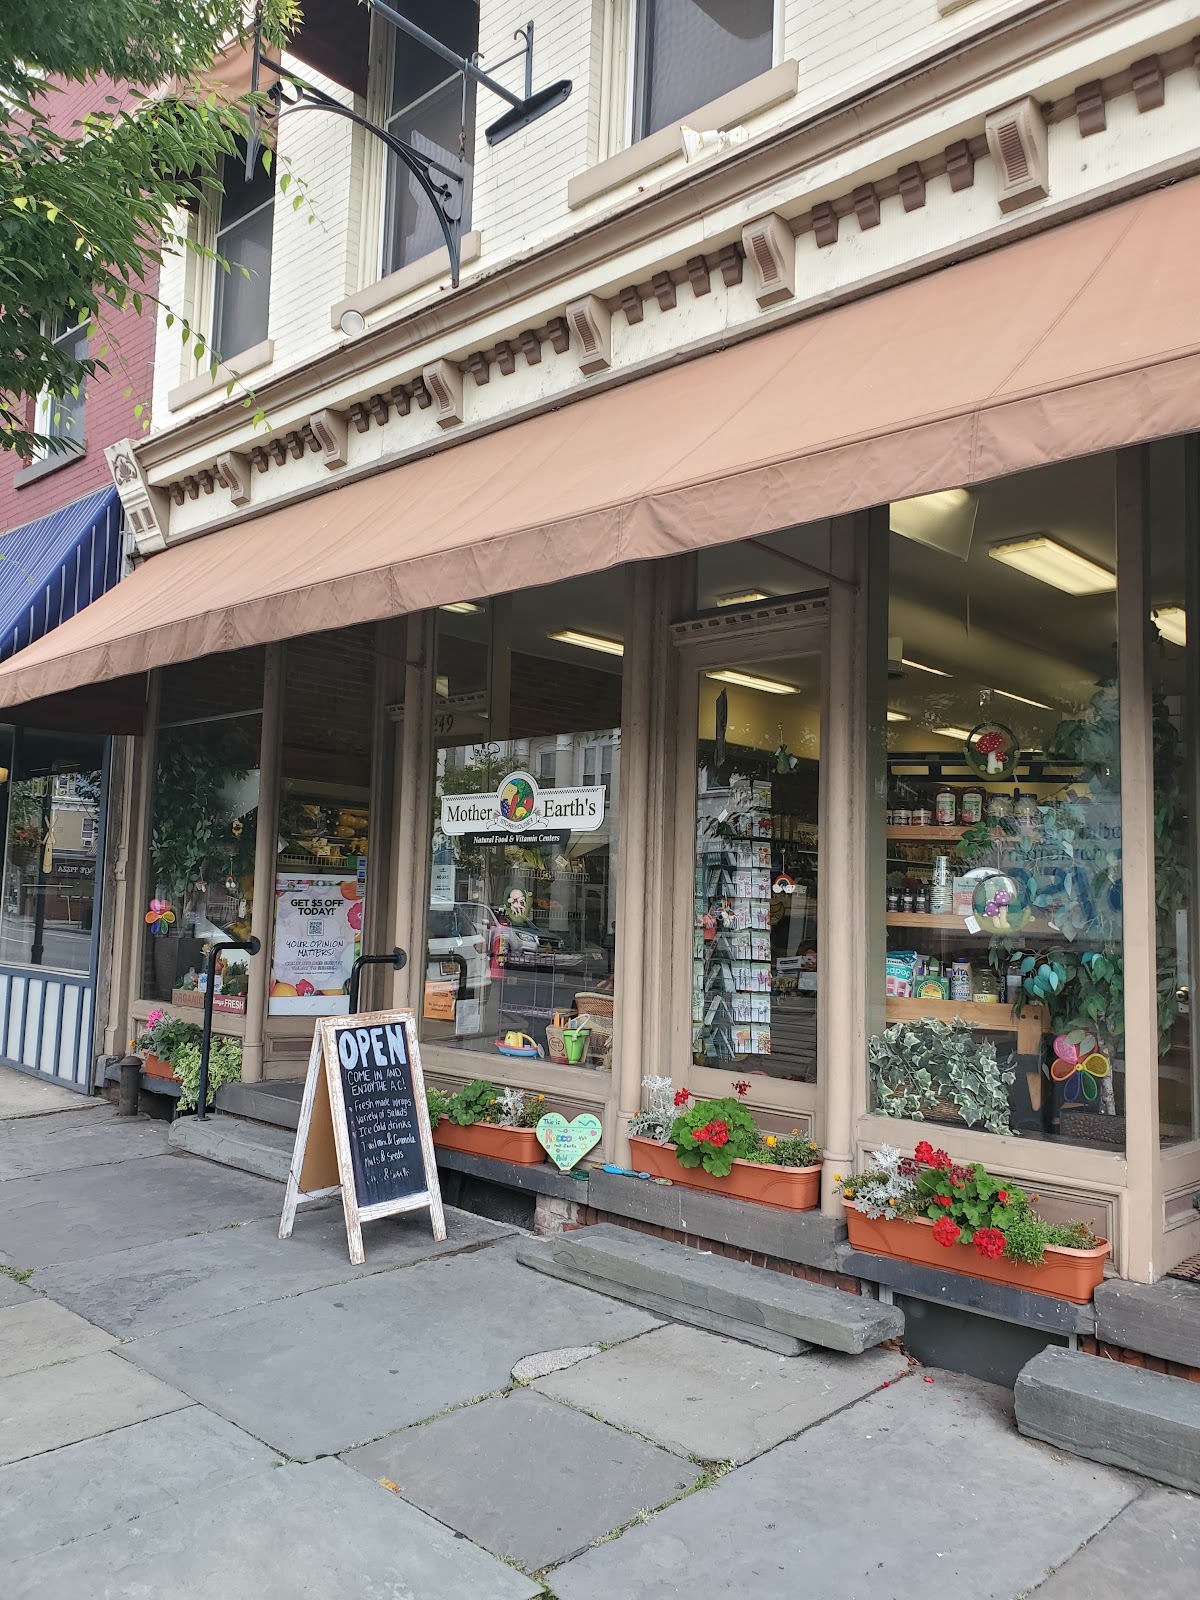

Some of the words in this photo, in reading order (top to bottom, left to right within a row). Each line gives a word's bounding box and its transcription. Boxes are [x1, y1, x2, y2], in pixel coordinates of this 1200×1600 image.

[447, 804, 492, 822] Mother
[543, 798, 596, 818] Earth's
[473, 836, 495, 844] Natural
[495, 835, 508, 843] Food
[516, 834, 538, 842] Vitamin
[538, 834, 560, 842] Centers
[311, 899, 322, 908] $5
[309, 940, 344, 948] OPINION
[298, 949, 334, 958] MATTERS!
[952, 968, 968, 976] VITA
[174, 992, 204, 1005] ORGANIC
[224, 998, 244, 1010] FRESH
[339, 1024, 406, 1070] OPEN
[348, 1070, 370, 1085] COME
[374, 1070, 382, 1080] IN
[387, 1068, 402, 1078] AND
[352, 1082, 374, 1096] ENJOY
[375, 1081, 388, 1092] THE
[354, 1098, 374, 1112] Fresh
[375, 1097, 390, 1107] made
[379, 1109, 384, 1120] of
[358, 1127, 372, 1138] Ice
[388, 1119, 412, 1131] drinks
[386, 1132, 392, 1145] &
[380, 1150, 386, 1162] &
[384, 1168, 389, 1180] &
